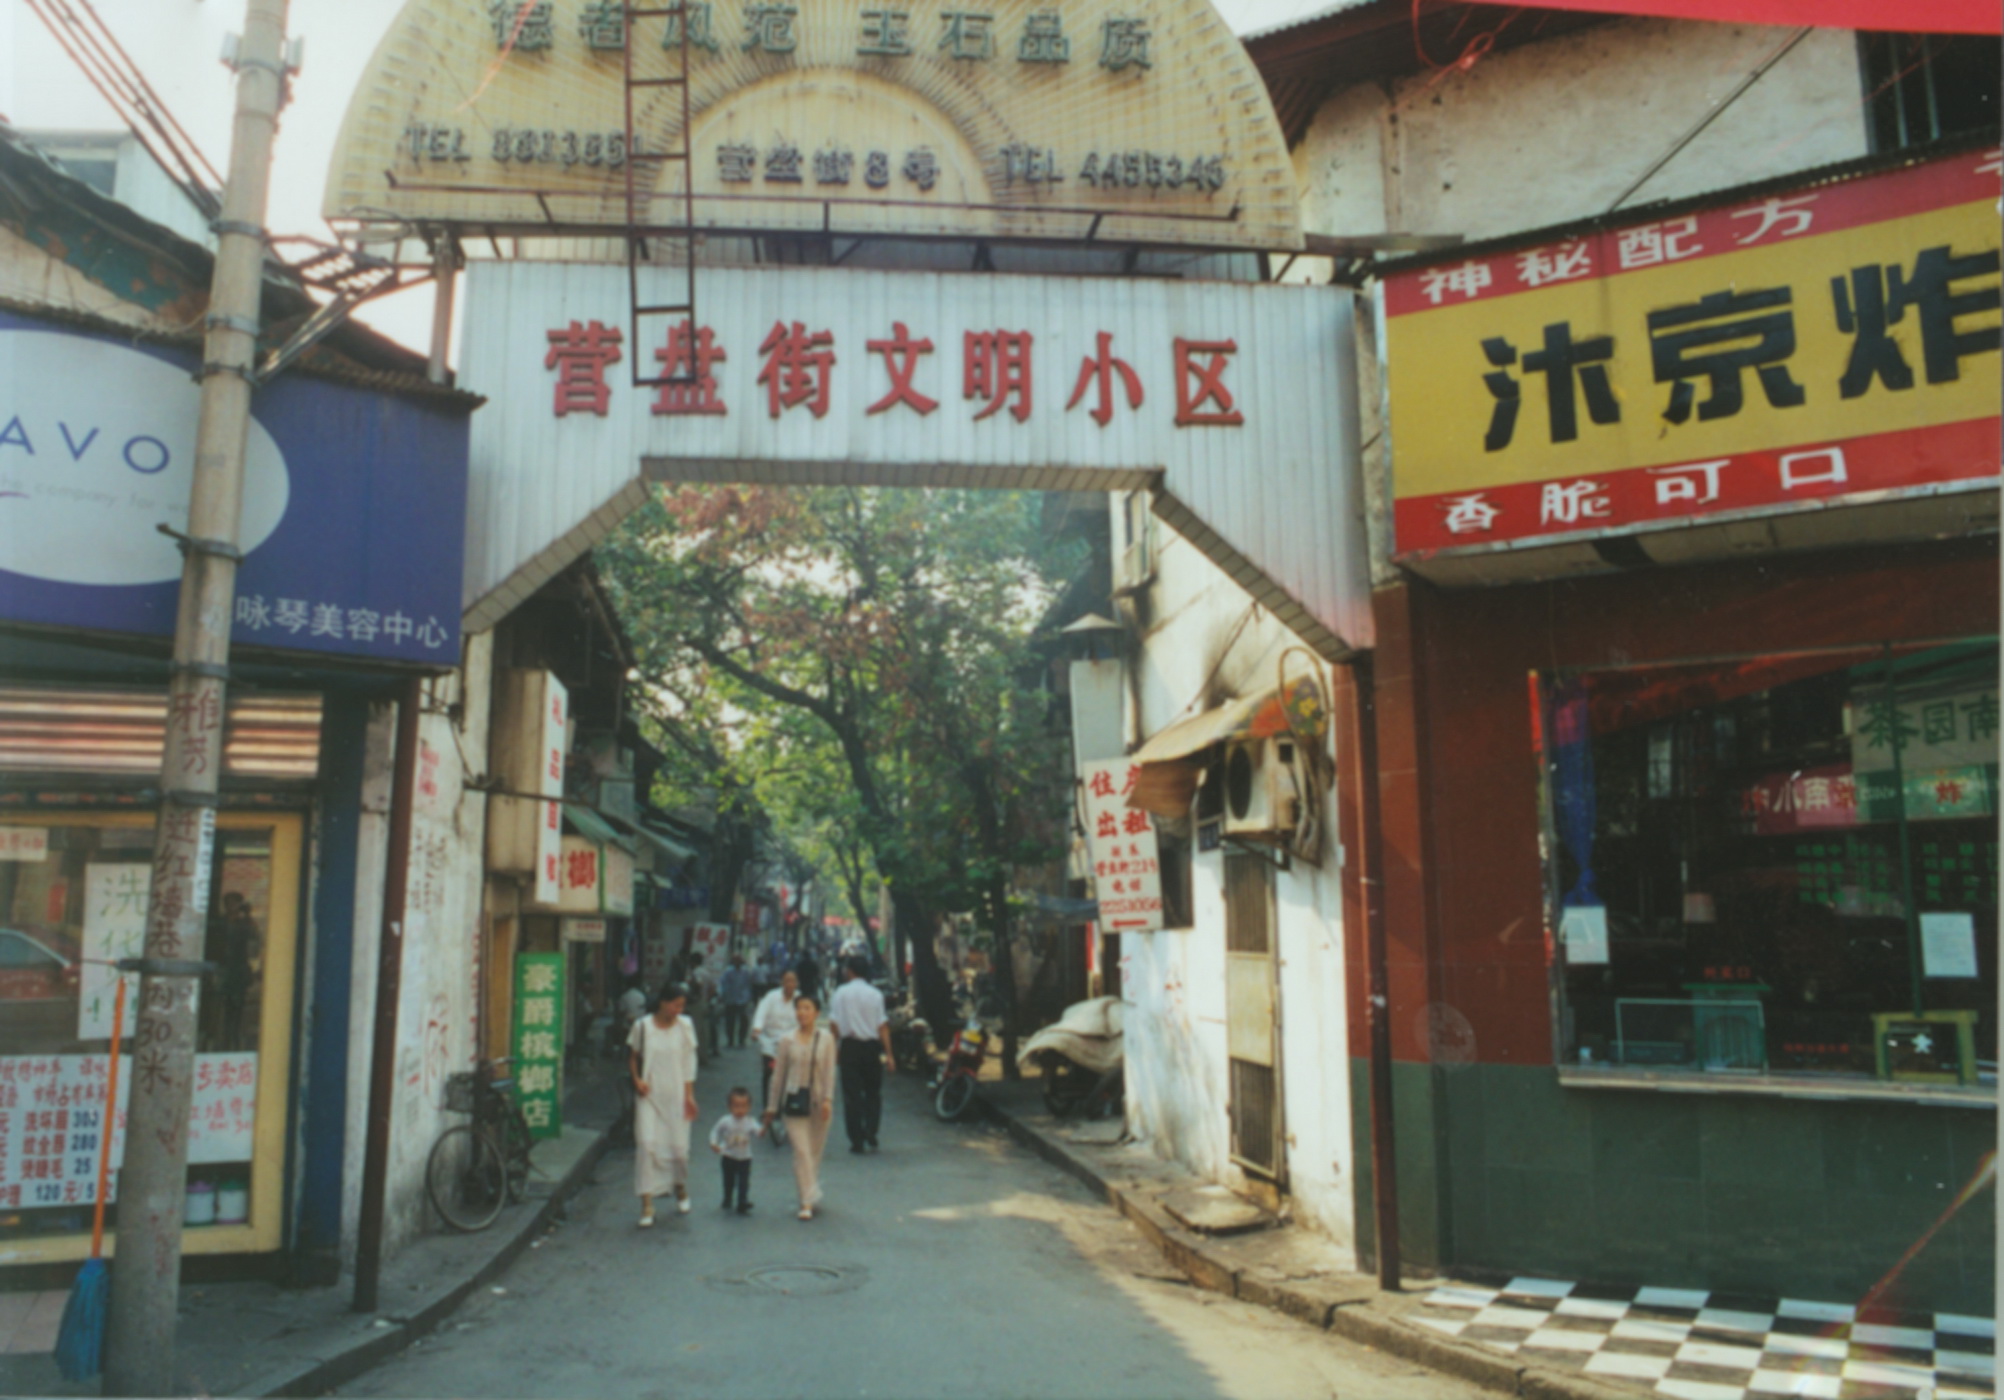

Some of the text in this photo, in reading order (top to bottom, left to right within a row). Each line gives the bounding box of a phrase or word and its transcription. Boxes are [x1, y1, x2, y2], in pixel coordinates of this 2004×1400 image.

[857, 9, 1151, 71] 玉石品质
[405, 126, 470, 163] TEL
[1000, 145, 1064, 184] TEL
[1419, 194, 1821, 303] 神秘配方
[545, 319, 1244, 428] 营盘街文明小区
[1481, 244, 2001, 452] 汴京炸
[1443, 446, 1849, 534] 香脆可口
[236, 594, 448, 649] 咏琴美容中心
[172, 688, 220, 775] 雅芳
[1096, 809, 1152, 839] 出租
[72, 1133, 97, 1152] 280
[74, 1157, 91, 1175] 25
